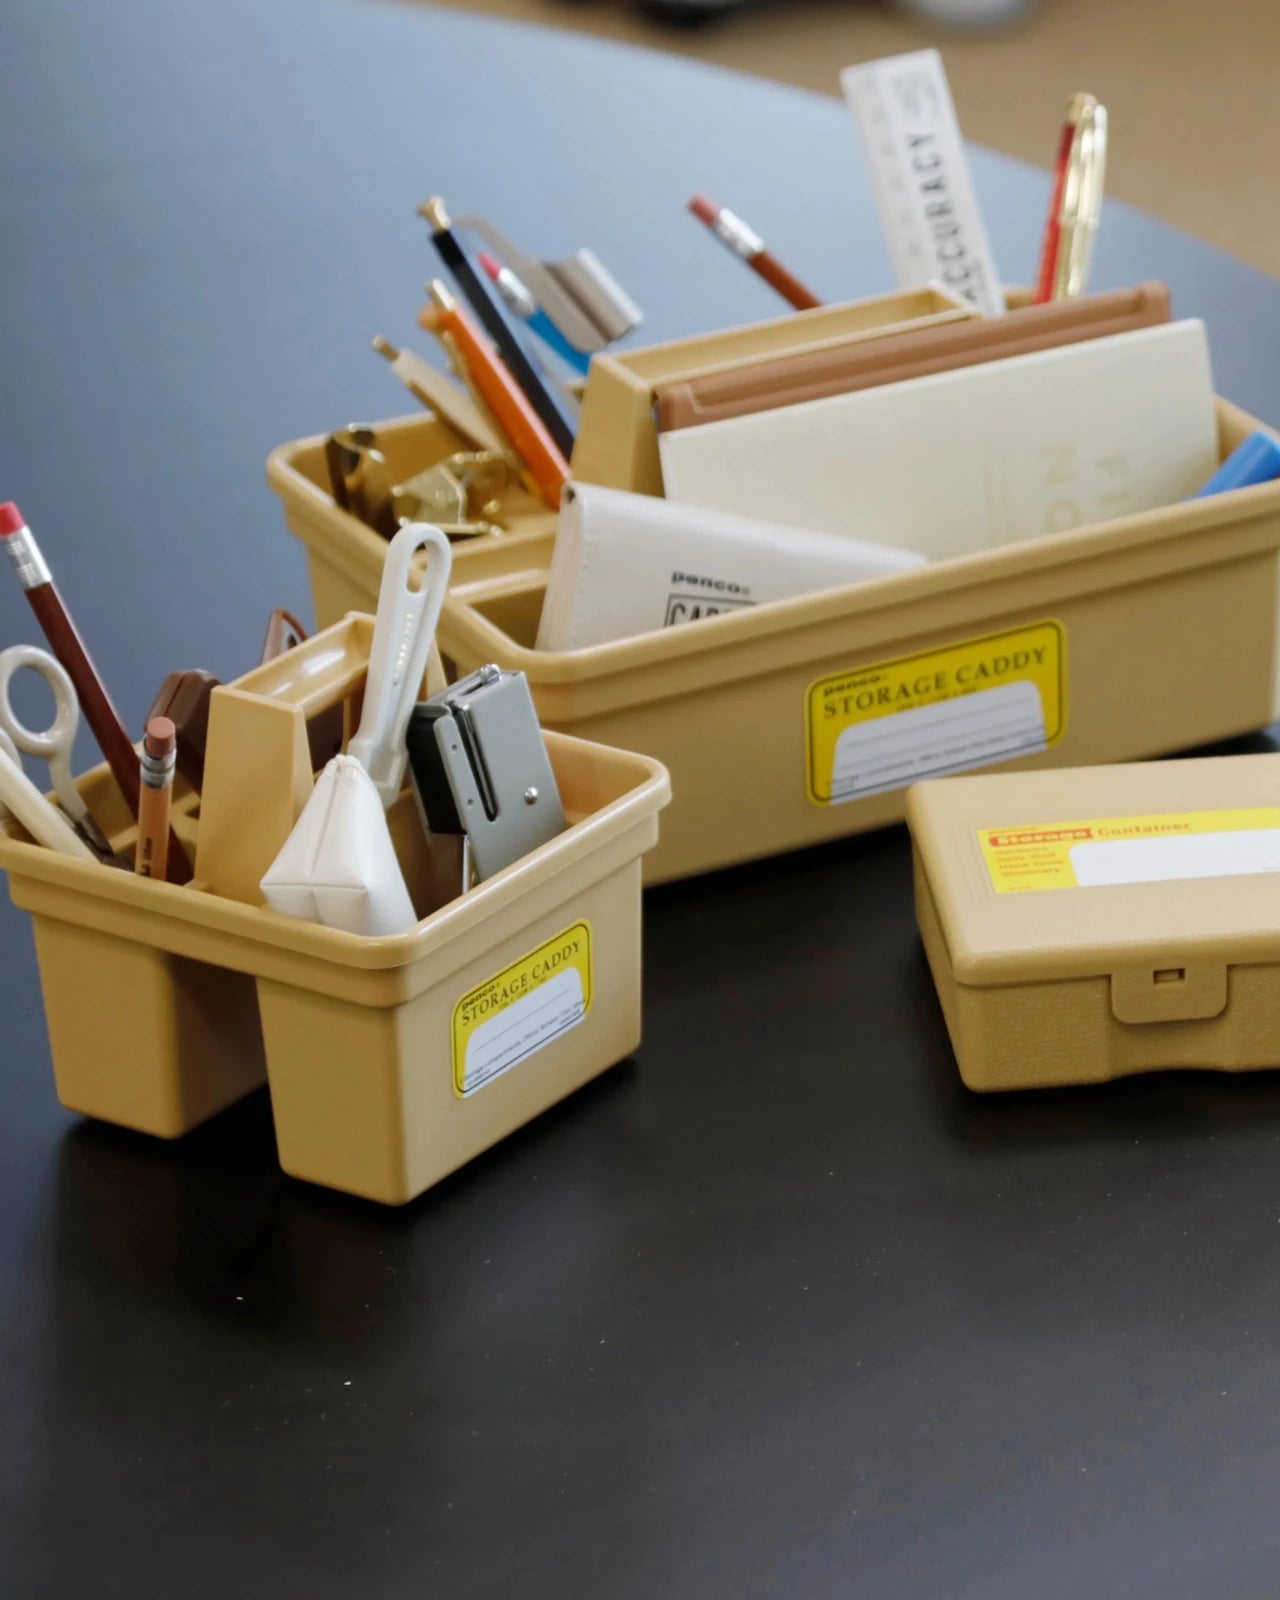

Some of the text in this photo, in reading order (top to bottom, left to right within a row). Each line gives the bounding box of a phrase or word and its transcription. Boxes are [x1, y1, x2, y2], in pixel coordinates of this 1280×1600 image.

[823, 670, 948, 719] STORAGE
[954, 645, 1048, 684] CADDY
[1098, 823, 1190, 836] Container
[461, 973, 528, 1027] STORAGE
[531, 939, 581, 980] CADDY
